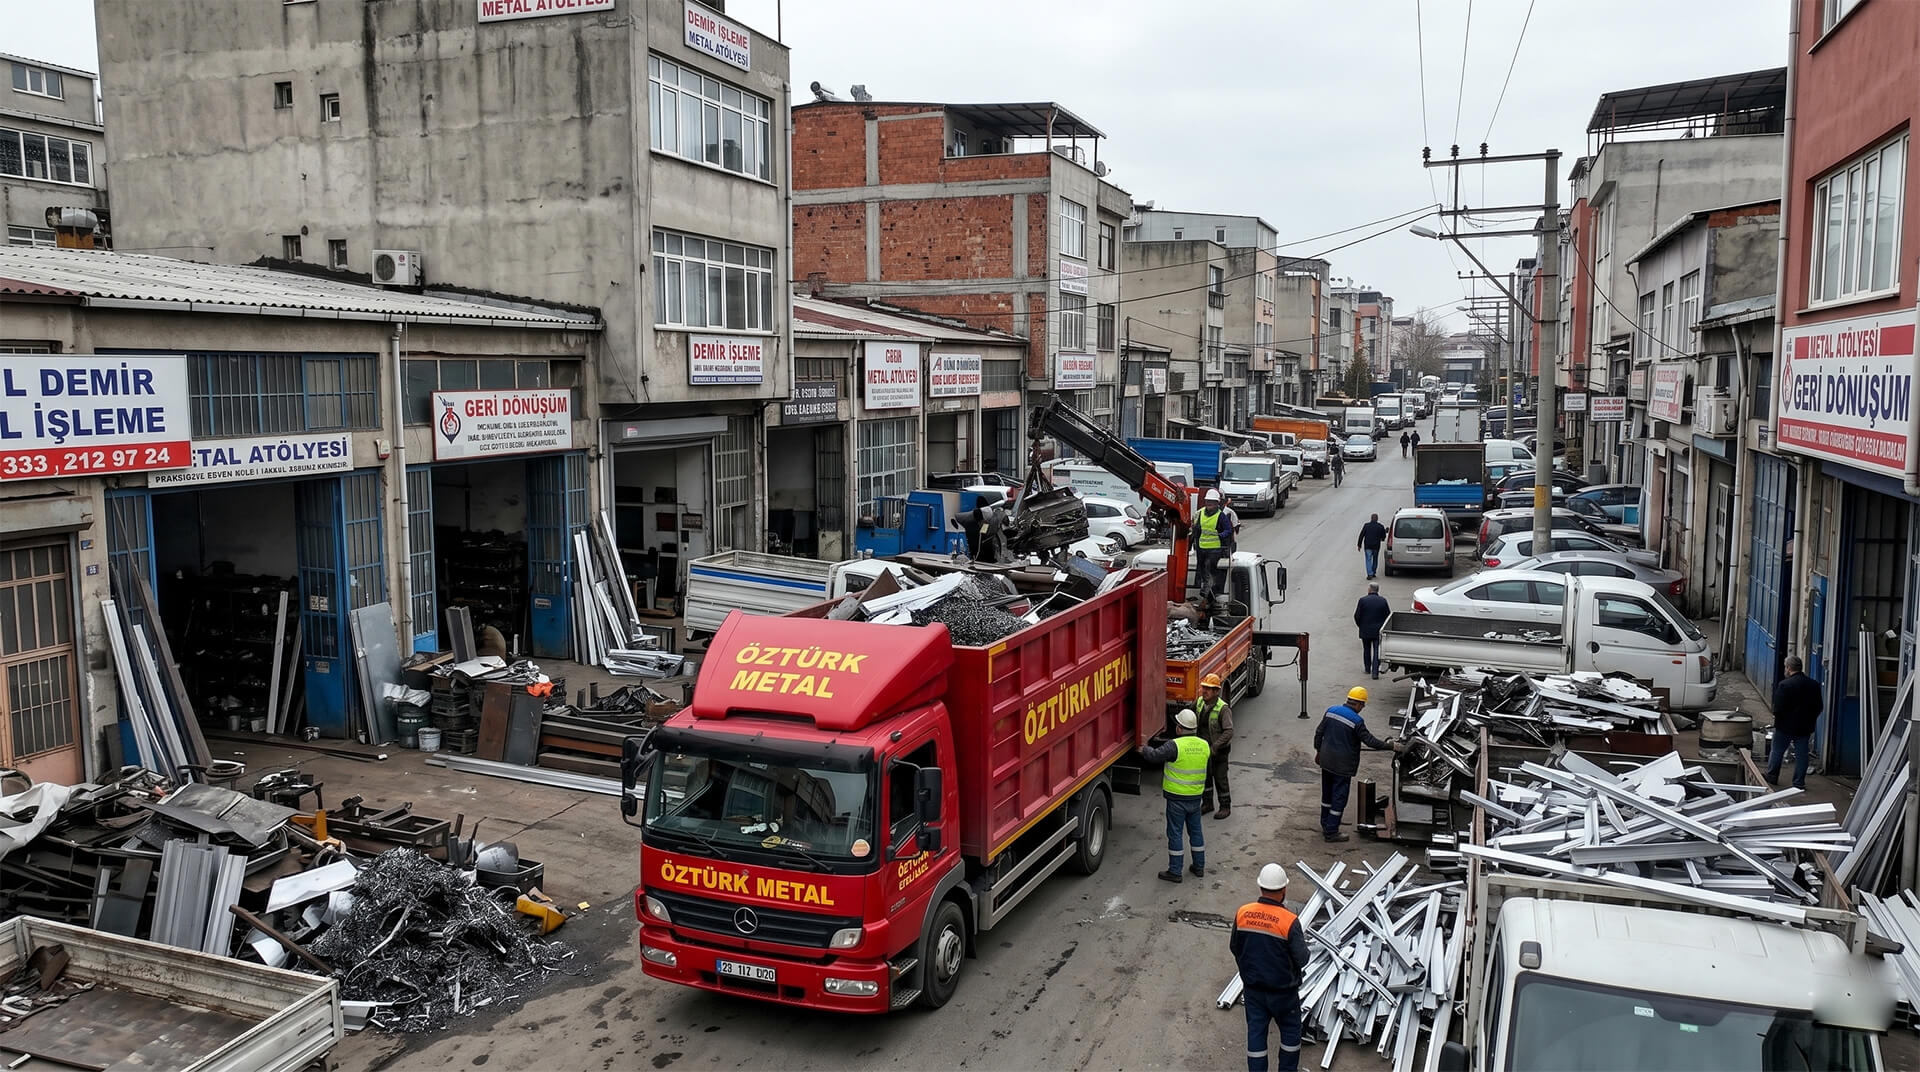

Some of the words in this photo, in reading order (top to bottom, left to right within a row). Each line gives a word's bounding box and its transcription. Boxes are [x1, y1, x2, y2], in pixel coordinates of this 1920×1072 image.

[688, 9, 716, 35] DEMİR
[718, 21, 748, 49] İŞLEME
[689, 30, 714, 52] METAL
[693, 339, 726, 360] DEMİR
[728, 340, 761, 364] İŞLEME
[1810, 334, 1834, 359] METAL
[1836, 322, 1879, 358] ATÖLYESİ
[39, 362, 156, 397] DEMİR
[867, 369, 889, 384] METAL
[464, 394, 498, 417] GERİ
[502, 392, 568, 419] DÖNÜŞÜM
[1793, 365, 1823, 412] GERİ
[1825, 365, 1911, 429] DÖNÜŞÜM
[34, 402, 166, 444] İŞLEME
[63, 450, 110, 471] 212
[111, 449, 139, 467] 97
[144, 447, 171, 465] 24
[249, 436, 348, 463] ATÖLYESİ
[735, 642, 869, 674] ÖZTÜRK
[729, 670, 834, 699] METAL
[1024, 675, 1091, 745] ÖZTÜRK
[1093, 650, 1135, 703] METAL
[661, 859, 750, 895] ÖZTÜRK
[756, 877, 835, 906] METAL
